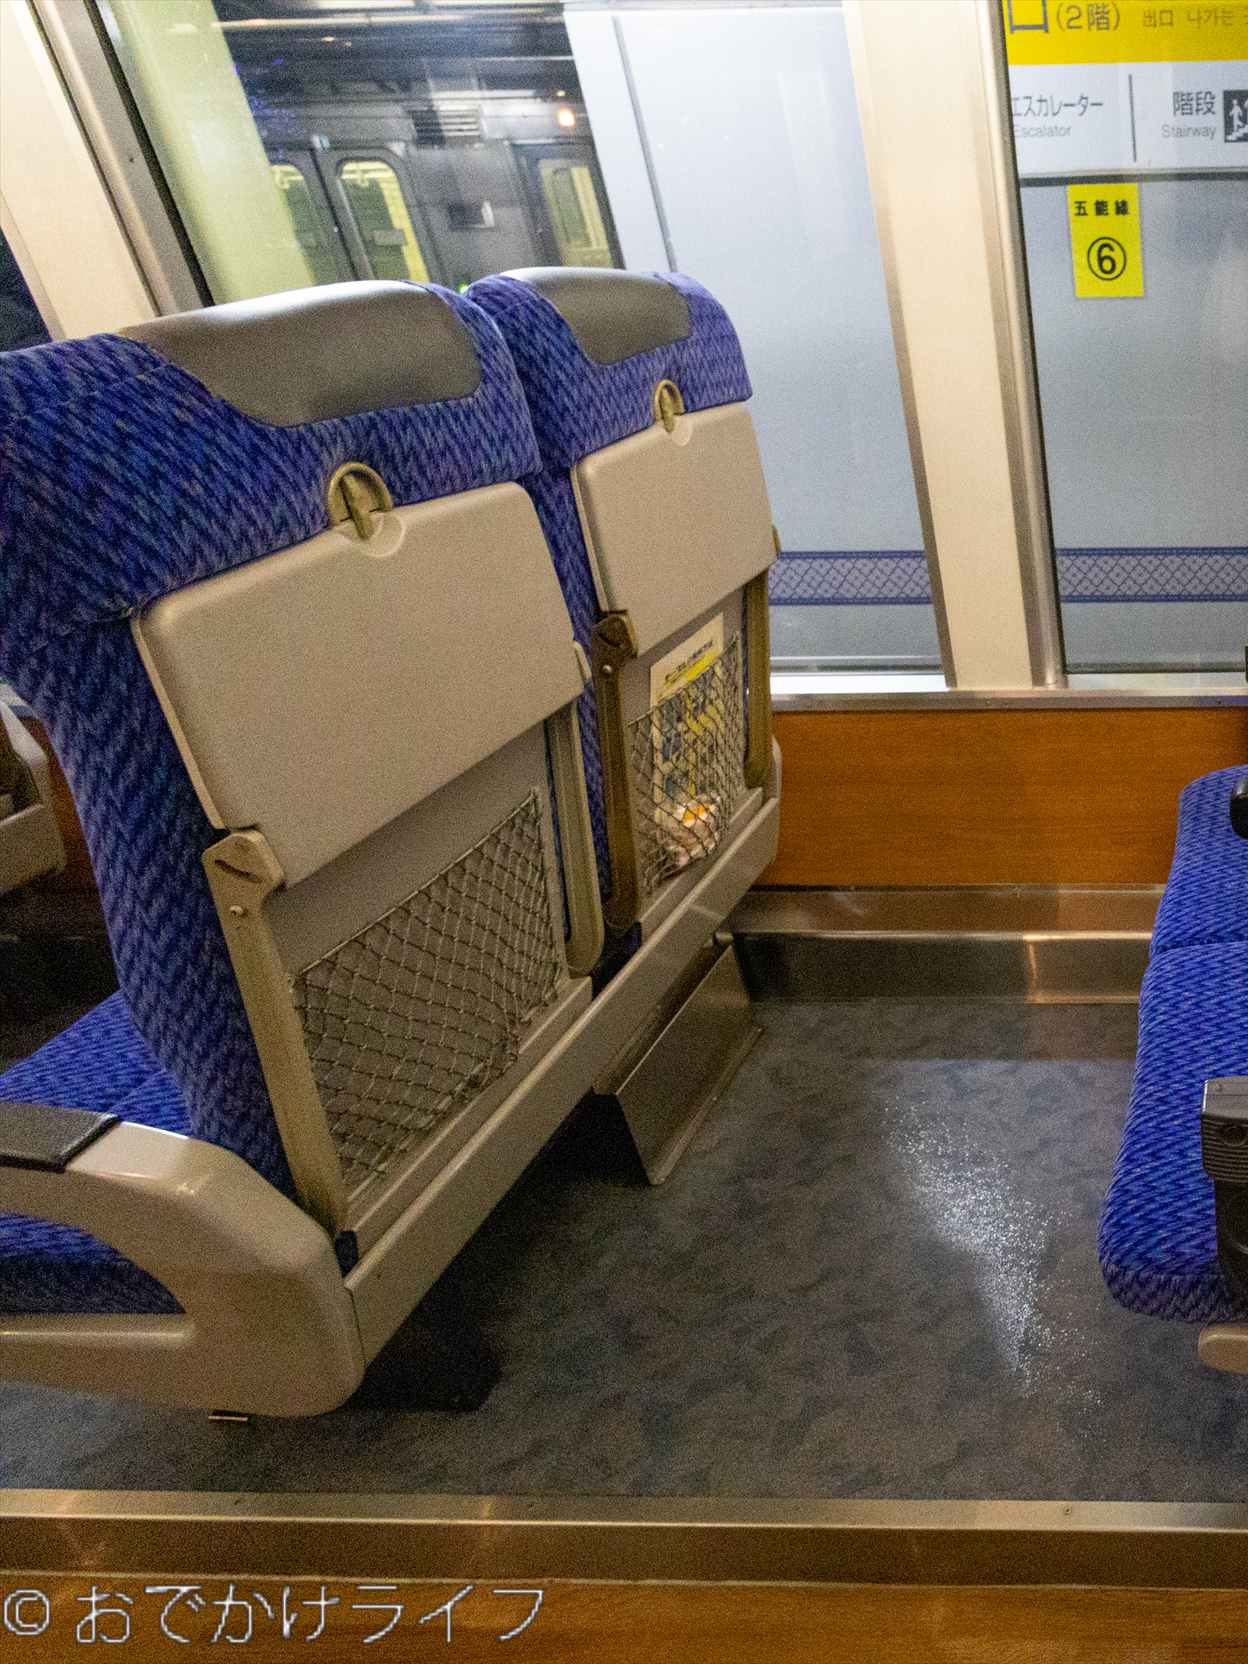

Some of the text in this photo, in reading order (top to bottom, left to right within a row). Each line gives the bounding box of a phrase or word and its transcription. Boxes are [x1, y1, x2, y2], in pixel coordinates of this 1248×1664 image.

[1012, 93, 1103, 117] エスカレーター
[1173, 91, 1217, 117] 階段
[1161, 124, 1217, 141] Stairway
